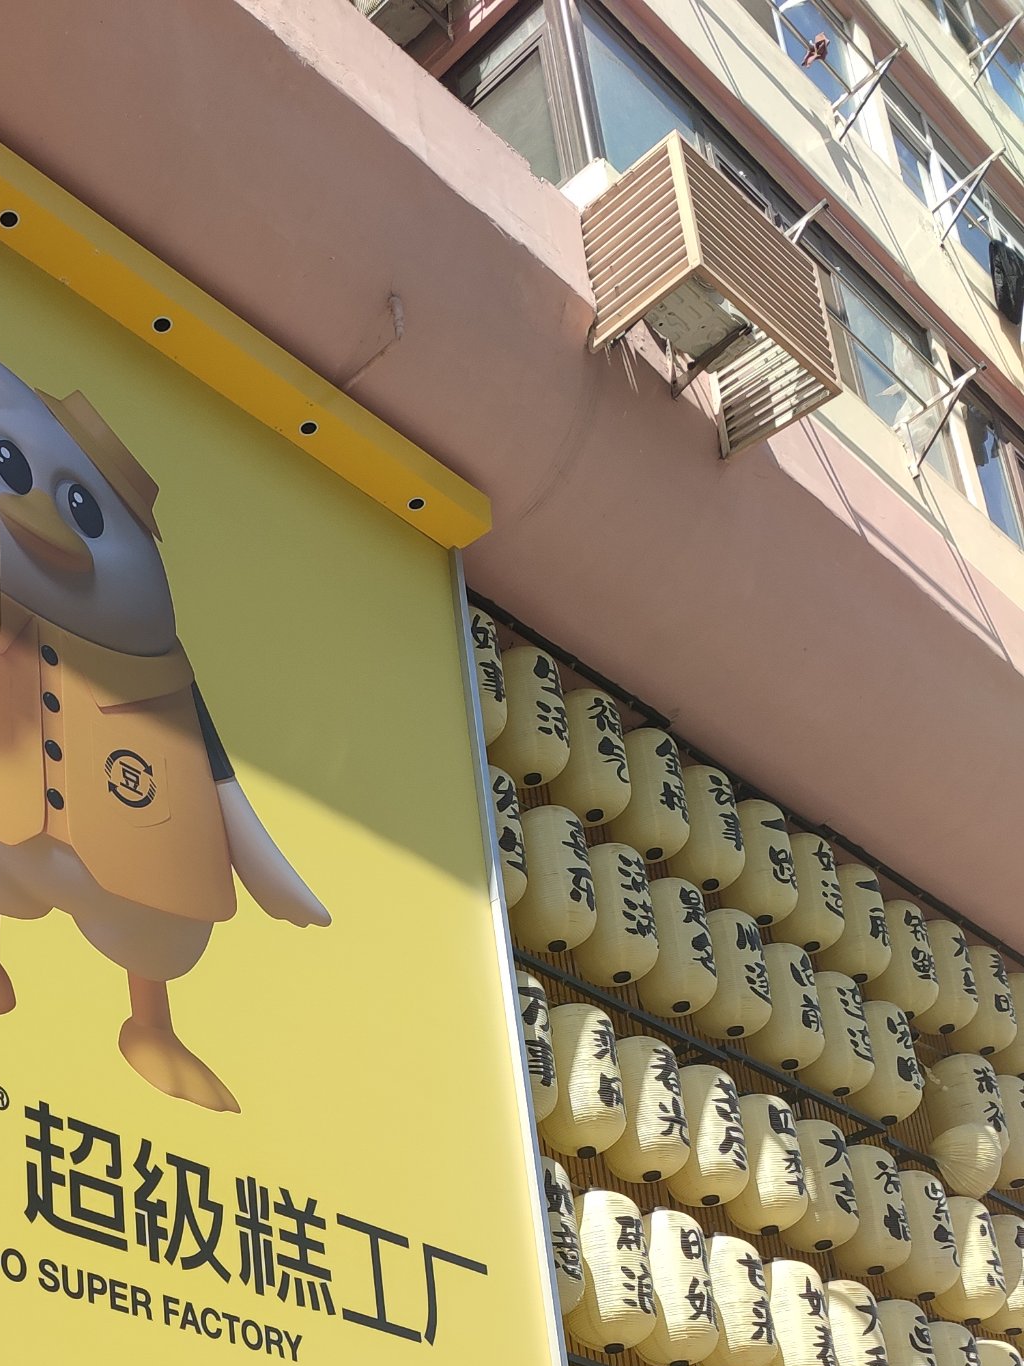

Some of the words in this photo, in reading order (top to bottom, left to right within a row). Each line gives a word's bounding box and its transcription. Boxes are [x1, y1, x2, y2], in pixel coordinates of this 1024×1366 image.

[119, 761, 142, 797] 豆
[518, 986, 556, 1087] 万事
[650, 1048, 692, 1148] 春光
[819, 1129, 860, 1220] 大吉
[38, 1258, 152, 1321] SUPER
[163, 1294, 302, 1362] FACTORY
